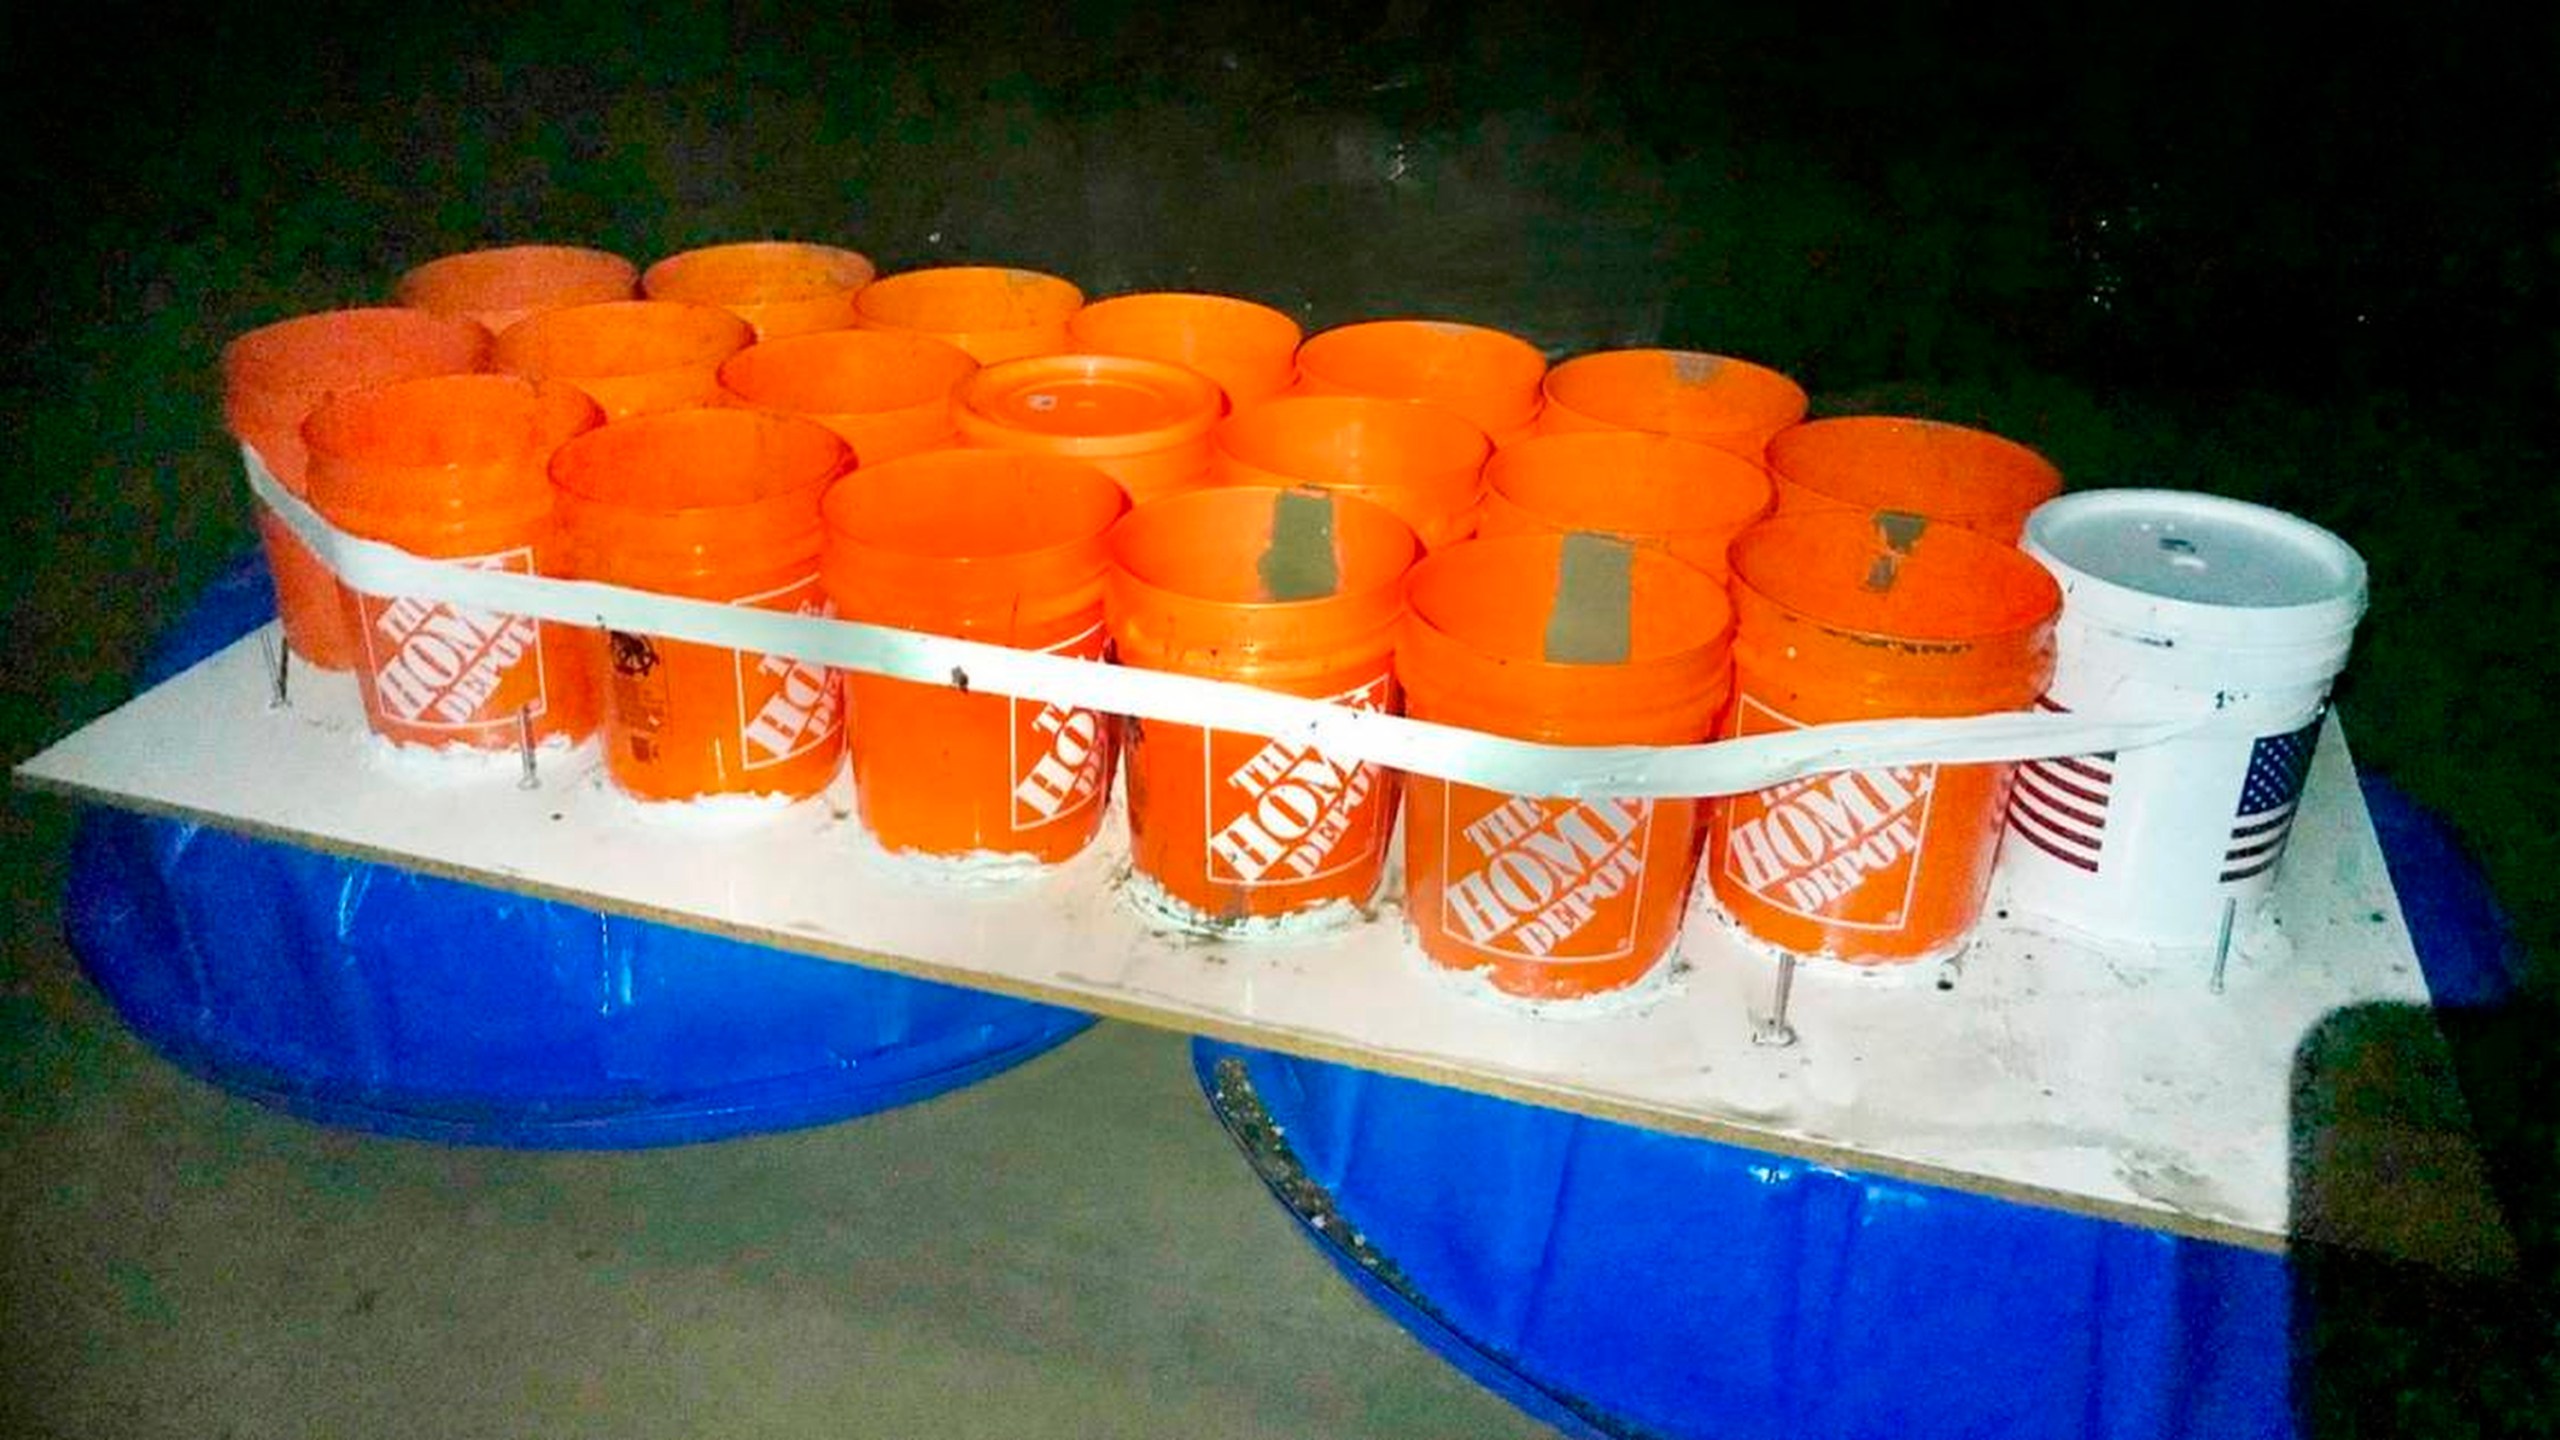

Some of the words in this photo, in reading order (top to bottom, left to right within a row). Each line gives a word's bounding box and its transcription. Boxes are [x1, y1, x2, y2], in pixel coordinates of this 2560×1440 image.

[1463, 797, 1551, 858] THE
[1785, 815, 1918, 913] DEPOT
[1514, 841, 1641, 956] DEPOT
